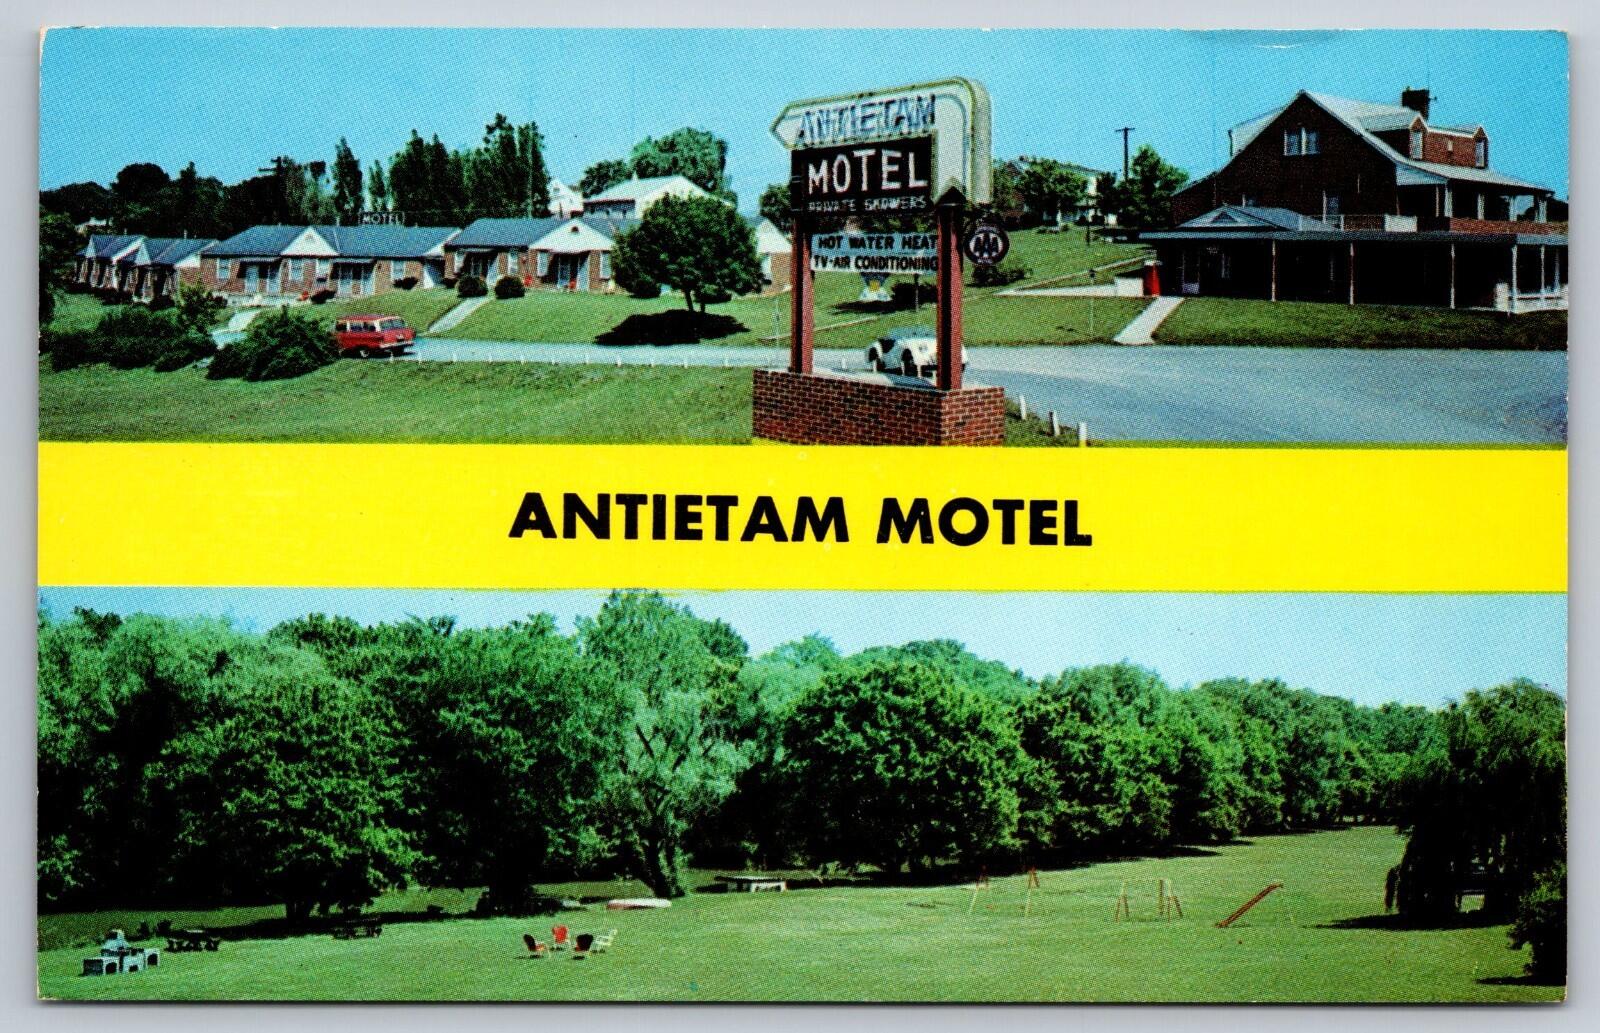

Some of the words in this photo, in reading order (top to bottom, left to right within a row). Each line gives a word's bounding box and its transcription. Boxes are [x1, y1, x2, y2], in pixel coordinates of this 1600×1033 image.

[796, 94, 936, 145] ANTIETAM
[808, 150, 928, 194] MOTEL
[818, 235, 844, 249] HOT
[848, 236, 895, 249] WATER
[901, 235, 938, 249] HEAT
[973, 233, 999, 257] AAA
[855, 255, 938, 270] CONDITIONING
[508, 492, 850, 543] ANTIETAM
[876, 497, 1093, 547] MOTEL
